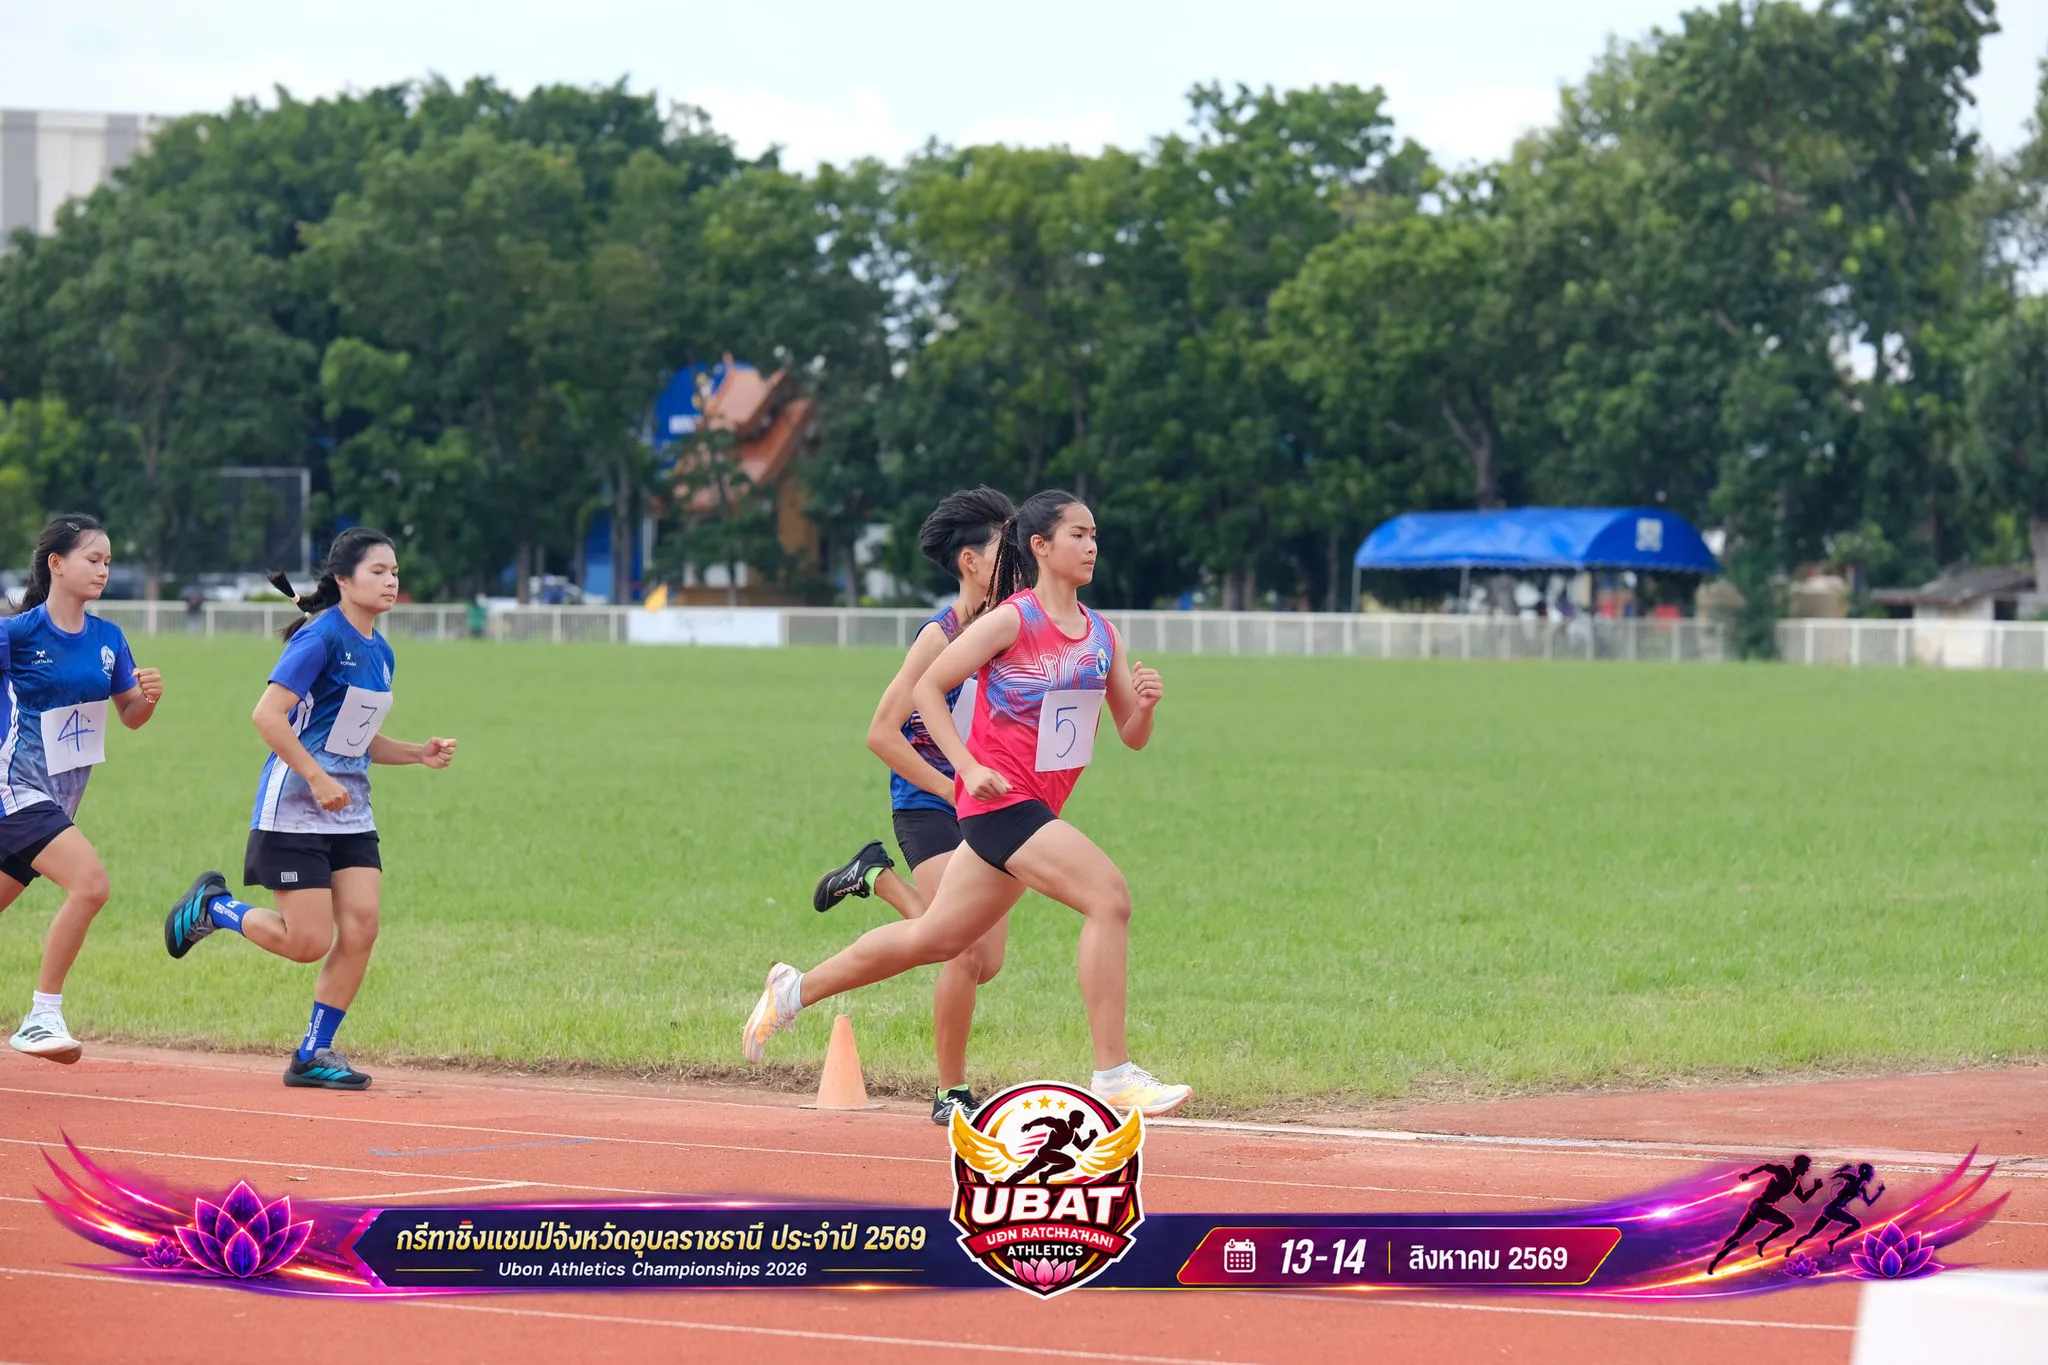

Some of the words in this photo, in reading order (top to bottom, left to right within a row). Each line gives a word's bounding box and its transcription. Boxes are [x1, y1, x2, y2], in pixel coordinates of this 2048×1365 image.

[57, 709, 95, 752] 4
[346, 705, 378, 747] 3
[1055, 706, 1078, 758] 5
